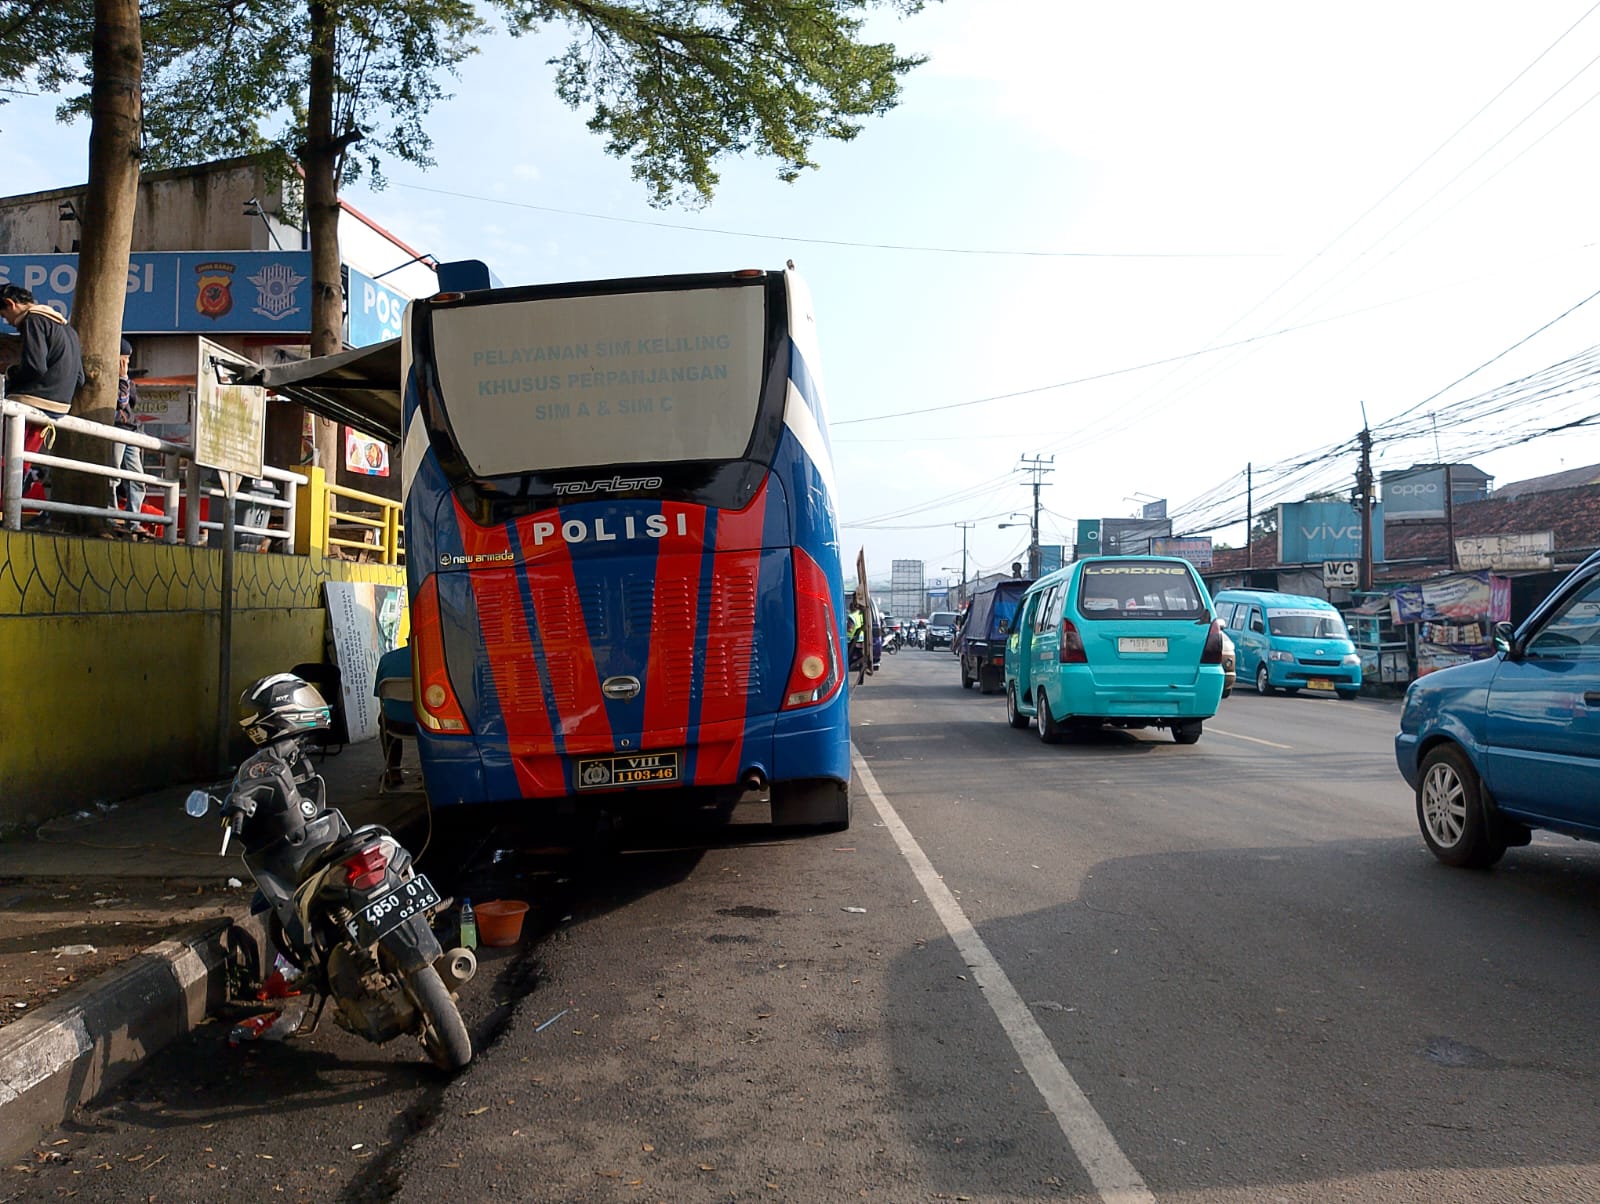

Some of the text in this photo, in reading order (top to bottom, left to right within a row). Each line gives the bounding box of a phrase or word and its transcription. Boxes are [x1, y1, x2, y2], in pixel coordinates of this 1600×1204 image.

[24, 263, 154, 294] POSI
[472, 335, 730, 367] PELAYANAN SIM KELILING
[478, 364, 729, 396] KHUSUS PERPANJANGAN
[535, 396, 672, 420] SIM A & SIM C
[1391, 482, 1438, 497] oppo
[532, 512, 688, 546] POLISI
[453, 549, 514, 564] new armada
[1327, 563, 1354, 575] WC
[628, 757, 660, 768] VIII
[617, 768, 673, 782] 1103-46
